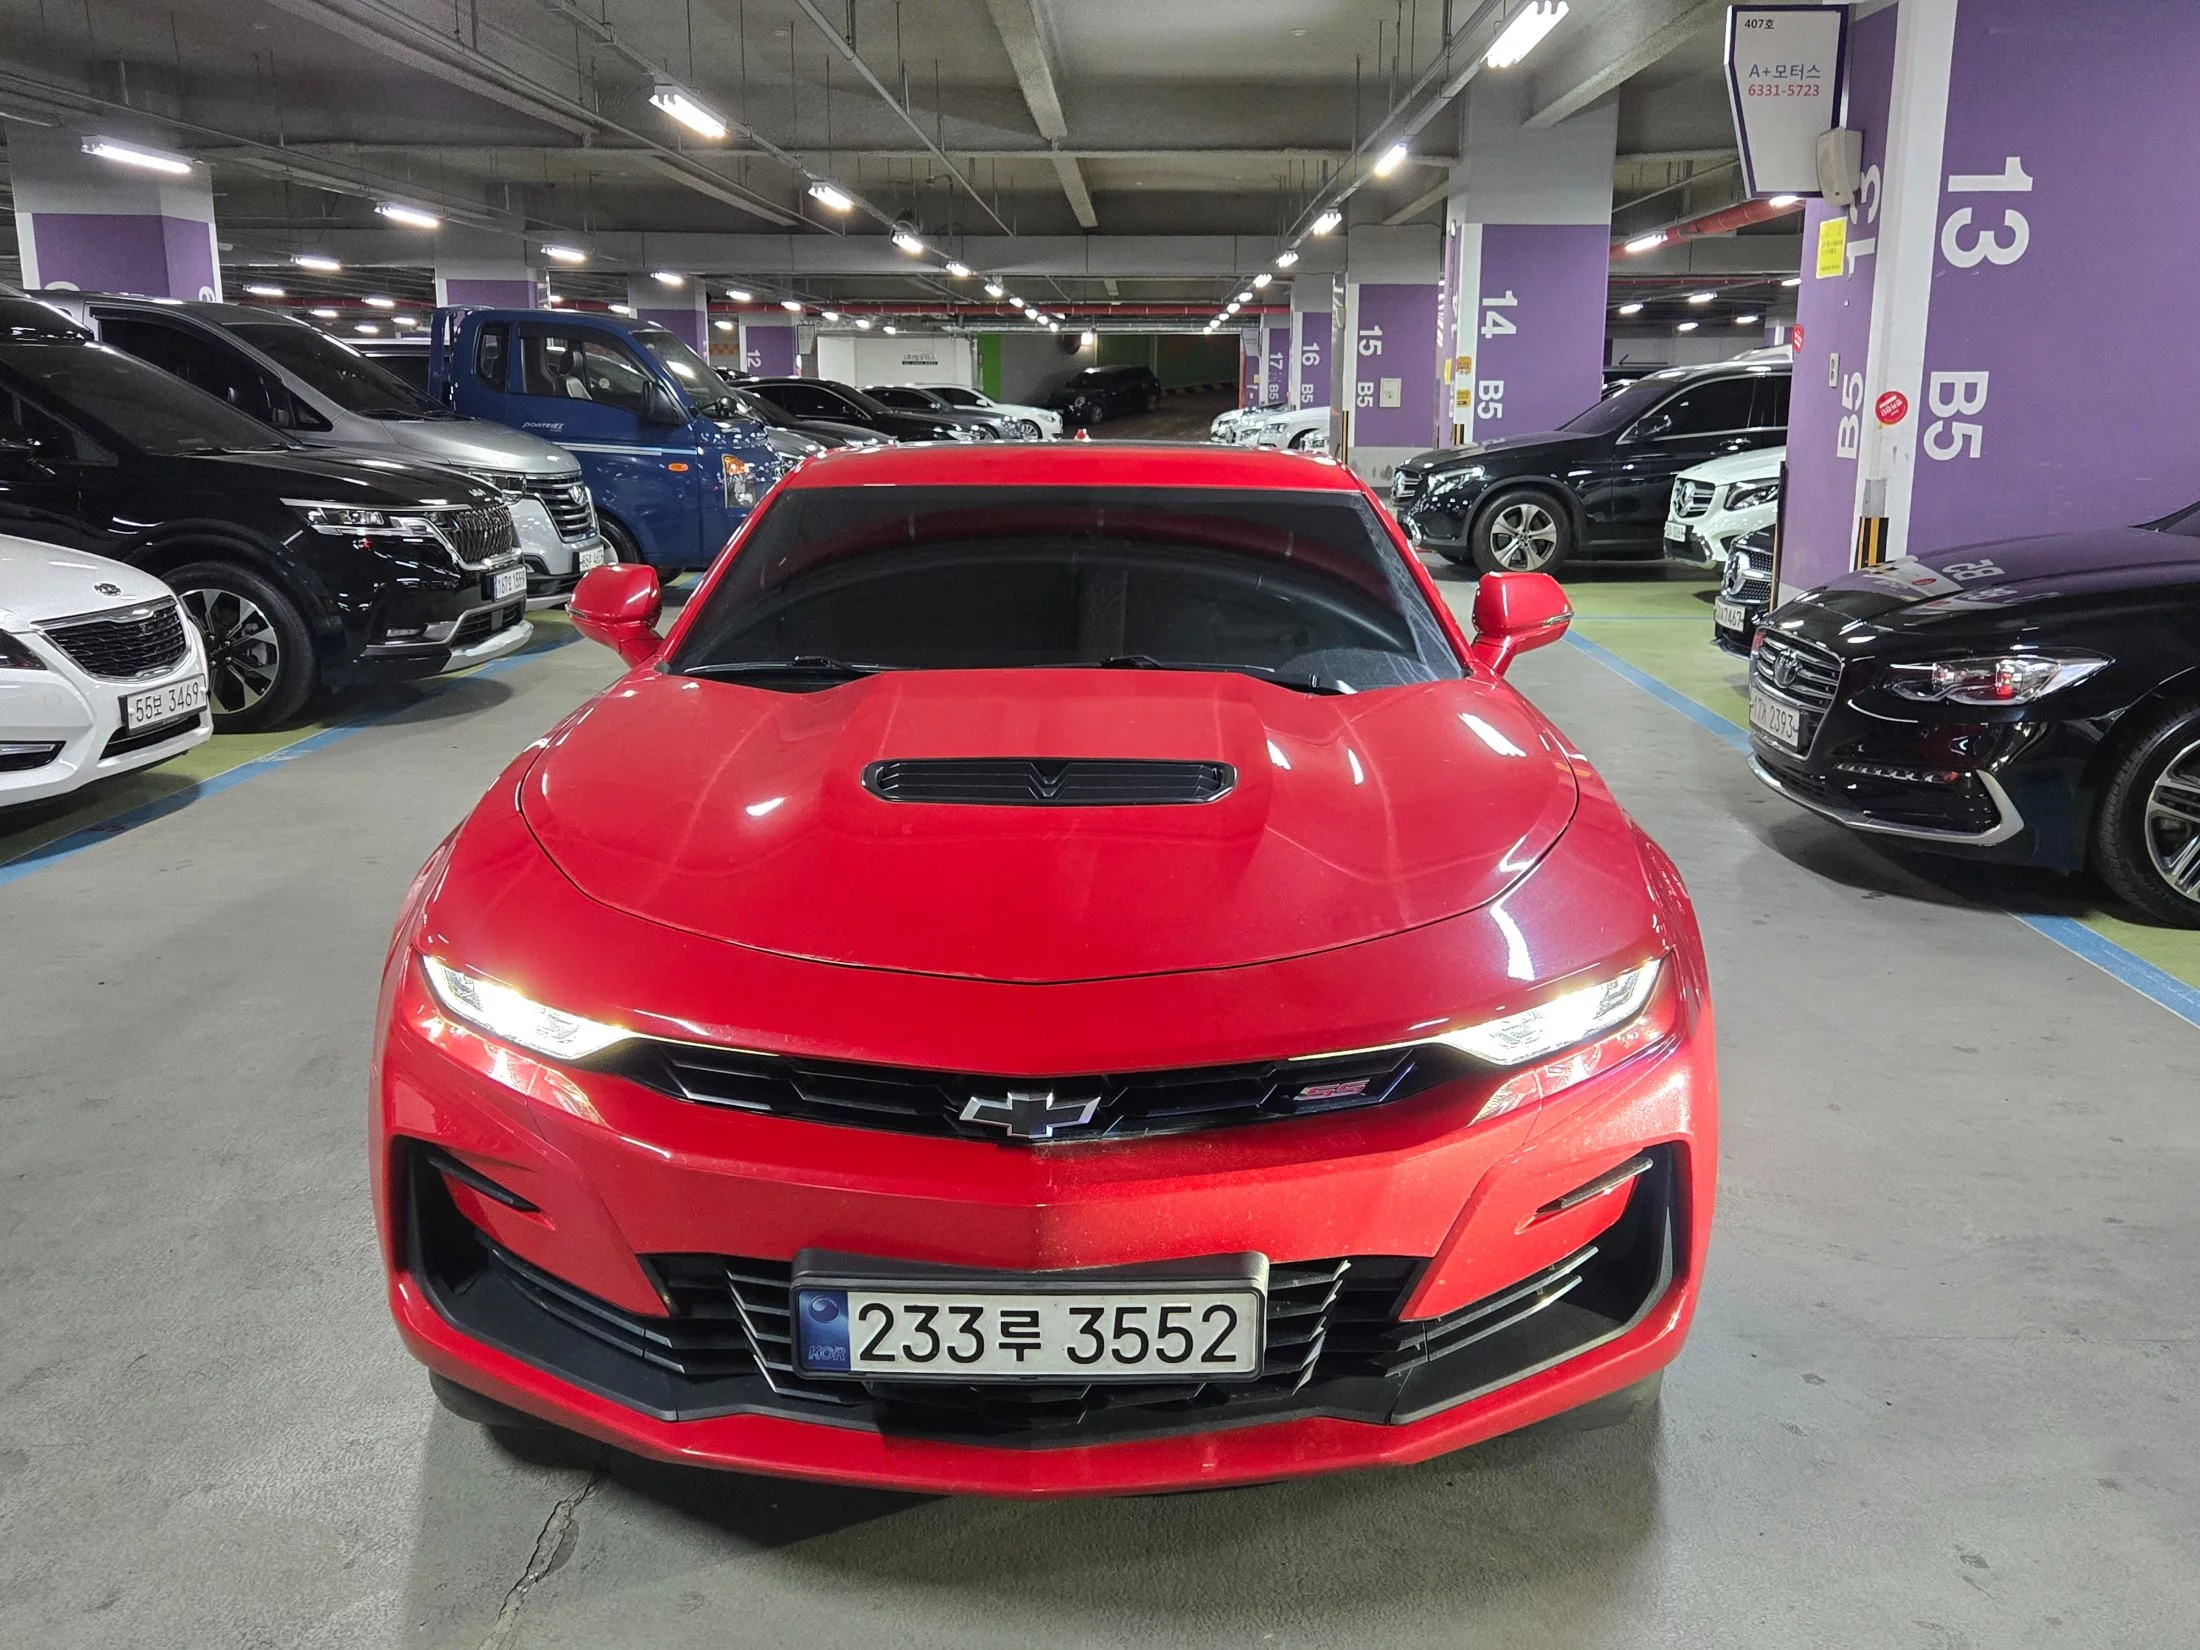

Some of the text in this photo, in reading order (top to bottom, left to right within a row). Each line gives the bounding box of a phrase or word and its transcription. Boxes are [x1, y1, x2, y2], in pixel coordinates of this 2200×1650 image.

[1744, 18, 1775, 30] 407호
[1748, 63, 1822, 81] A+모터스
[1747, 83, 1821, 97] 6331-5723
[1923, 156, 2034, 462] 13 B5
[746, 349, 762, 368] 12
[1356, 324, 1384, 408] 15 B5
[1476, 290, 1519, 420] 14 B5
[1268, 351, 1284, 400] 17 B5
[1301, 342, 1321, 404] 16 B5
[1836, 371, 1864, 460] B5
[168, 681, 200, 713] 3469
[1769, 705, 1794, 739] 2393
[1294, 1079, 1370, 1101] SS
[857, 1302, 1238, 1365] 233루 3552
[807, 1344, 847, 1362] KOR
